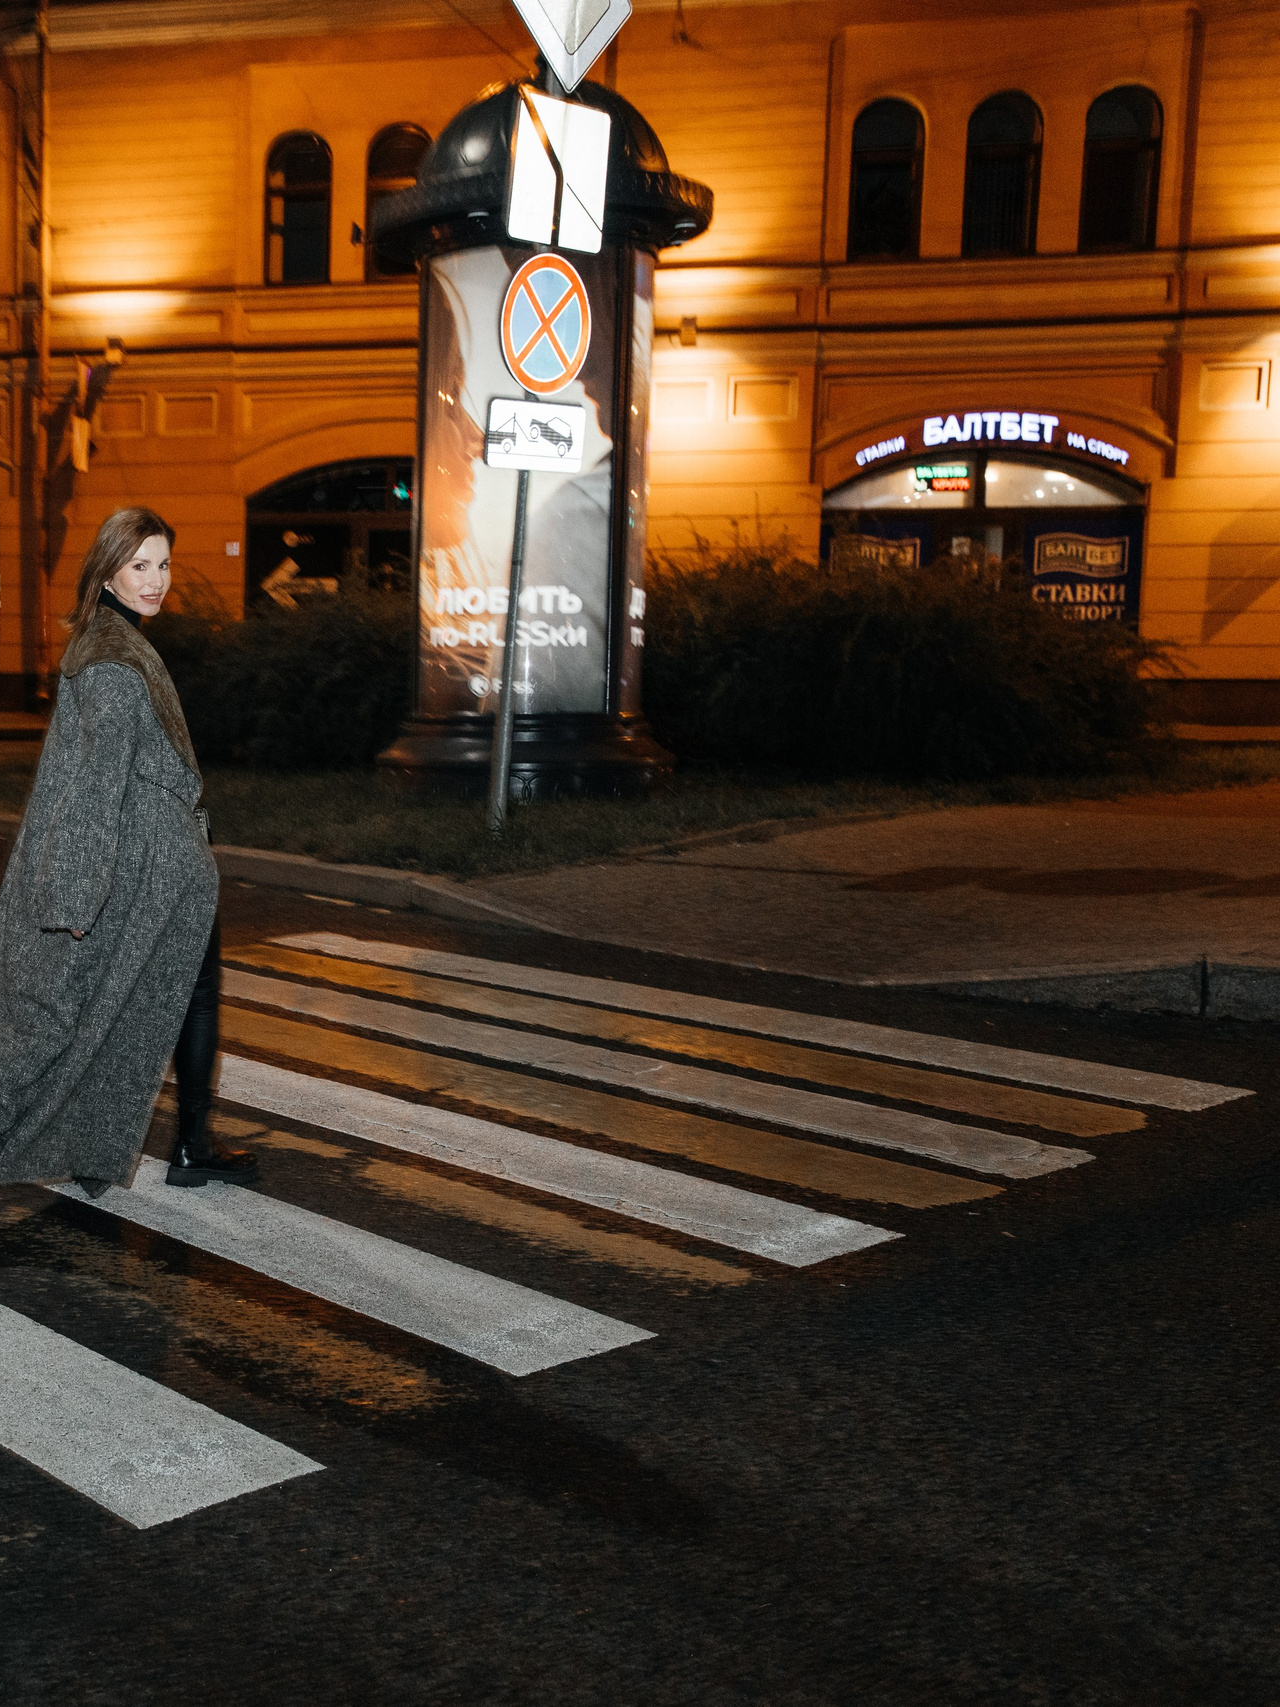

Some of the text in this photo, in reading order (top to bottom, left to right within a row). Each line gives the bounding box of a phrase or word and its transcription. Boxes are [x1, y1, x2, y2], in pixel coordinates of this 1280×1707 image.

[923, 412, 1059, 446] БАЛТБЕТ
[855, 436, 906, 467] СТАВКИ
[1067, 432, 1129, 466] НА СПОРТ
[1031, 583, 1125, 603] СТАВКИ
